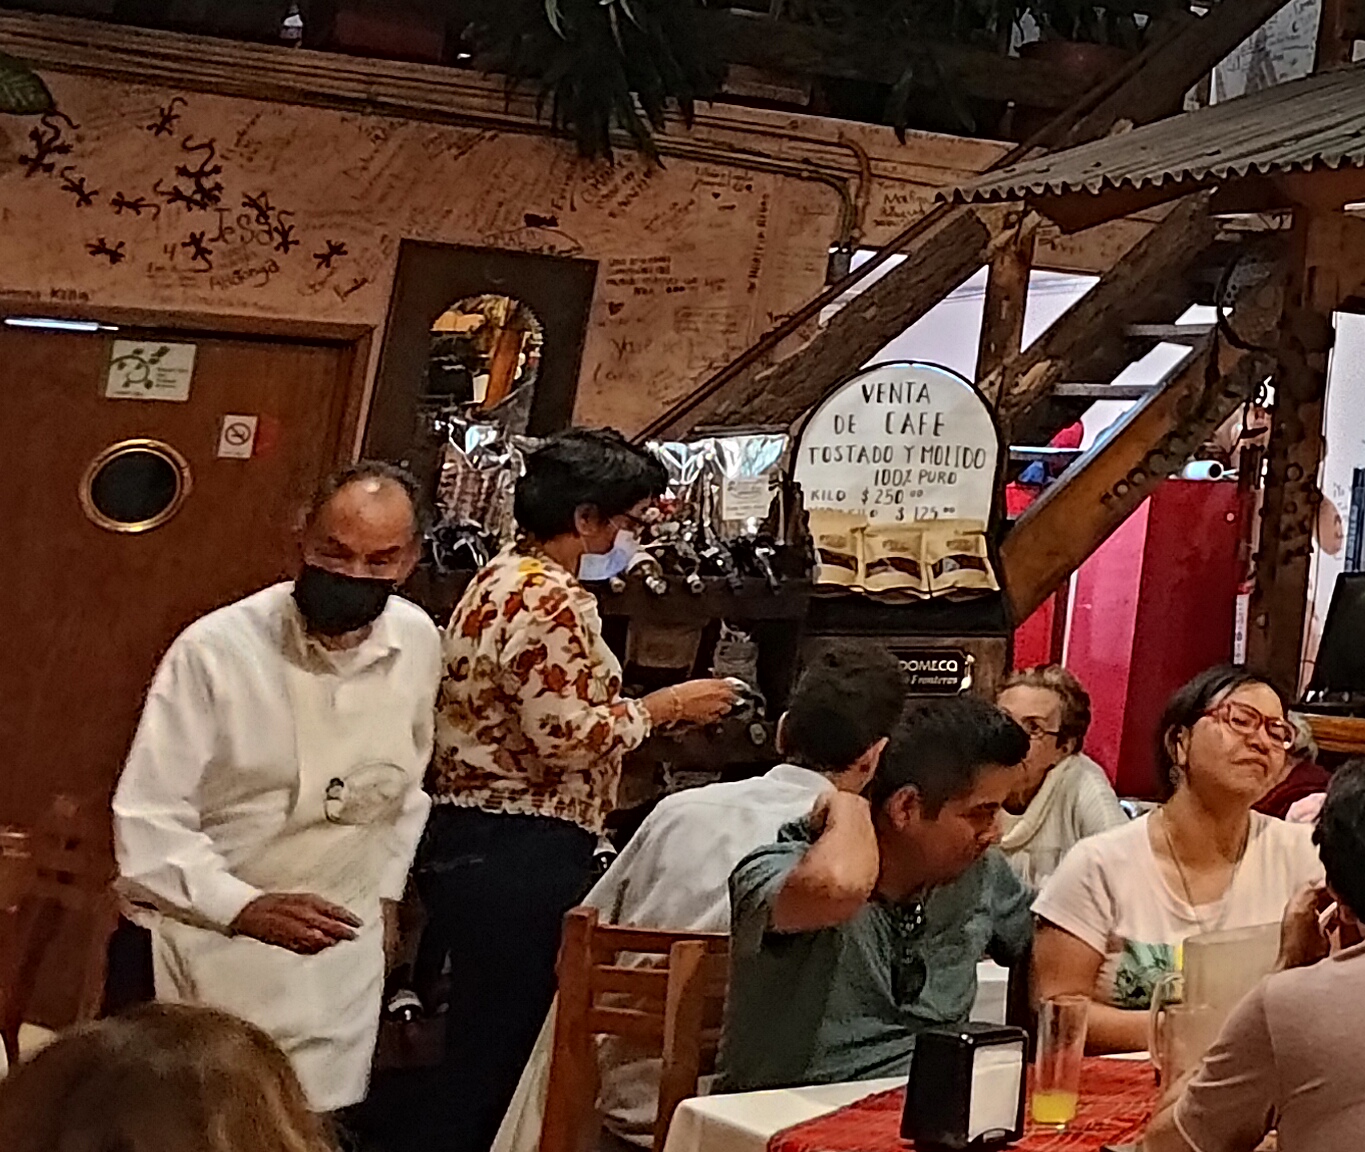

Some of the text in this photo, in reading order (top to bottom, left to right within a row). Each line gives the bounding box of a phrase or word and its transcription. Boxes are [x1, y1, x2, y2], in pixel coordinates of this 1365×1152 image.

[862, 382, 930, 404] VENTA
[834, 411, 945, 437] DE CAFE
[808, 445, 986, 469] TOSTADO Y MOLIDO
[874, 469, 957, 487] 100% PURO
[811, 489, 846, 502] KILO
